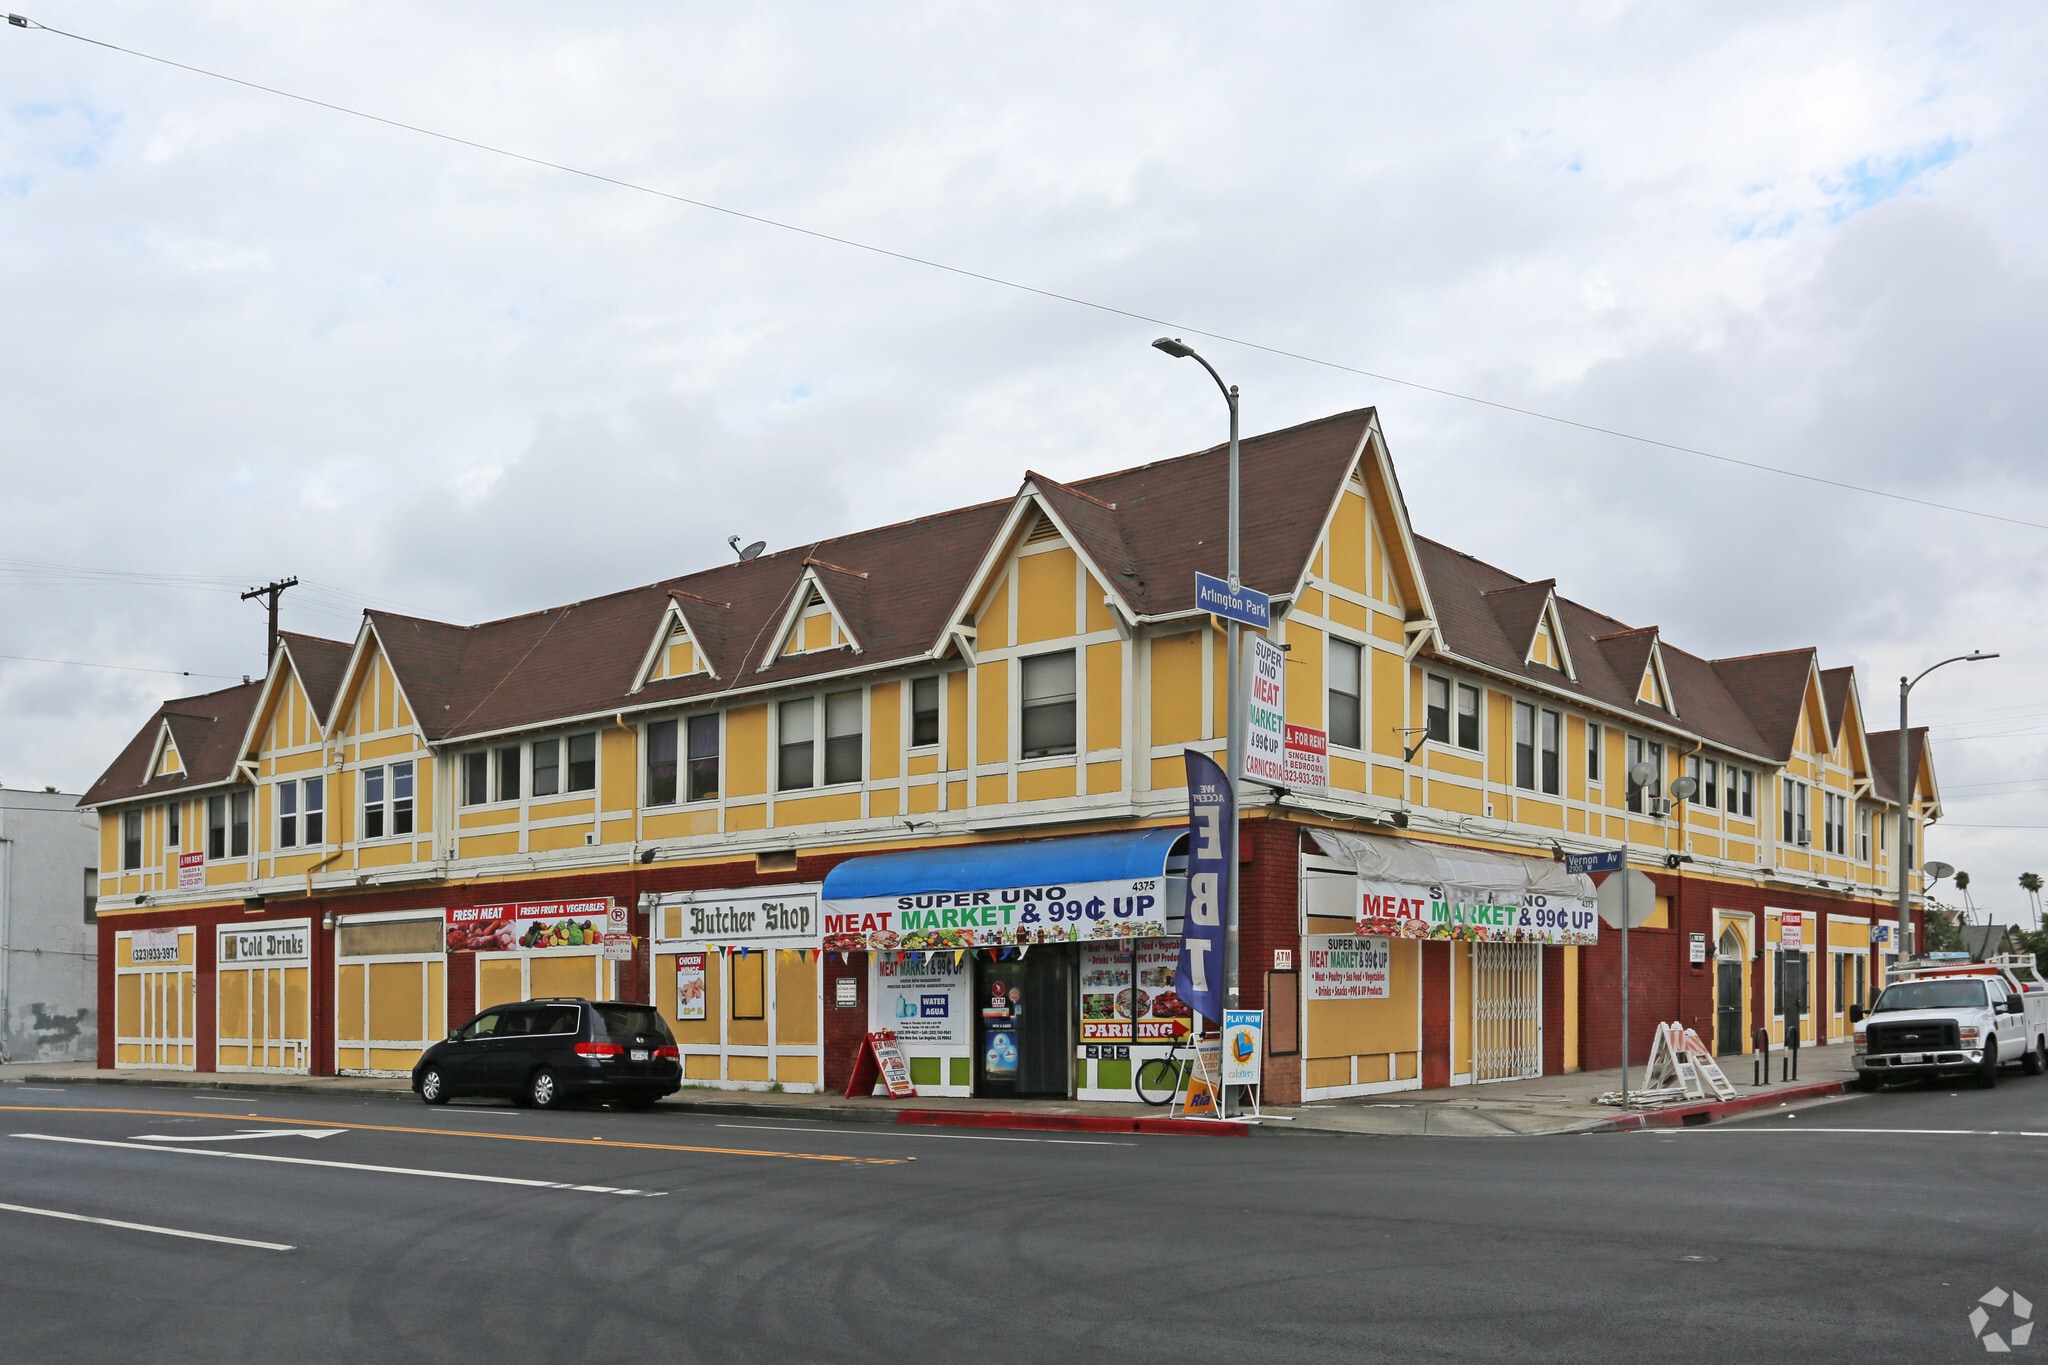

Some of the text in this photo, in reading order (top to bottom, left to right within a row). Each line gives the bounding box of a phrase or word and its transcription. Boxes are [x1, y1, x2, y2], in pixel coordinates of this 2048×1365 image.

[1201, 586, 1266, 617] Arlington Park
[1256, 642, 1282, 668] SUPER
[1259, 660, 1276, 680] UNO
[1254, 675, 1280, 707] MEAT
[1250, 704, 1283, 734] MARKET
[1255, 733, 1269, 752] 99¢
[1269, 739, 1279, 754] UP
[1294, 731, 1326, 750] FOR RENT
[1288, 751, 1321, 764] SINGLES &
[1246, 755, 1283, 782] CARNICERIA
[1290, 761, 1323, 774] BEDROOMS
[1285, 769, 1326, 787] 323-933-3971
[1569, 853, 1617, 866] Vernon Av
[1569, 865, 1583, 873] 2100
[1132, 881, 1156, 892] 4375
[897, 887, 1067, 910] SUPER UNO
[1581, 900, 1594, 909] 4375
[453, 907, 503, 921] FRESH MEAT
[520, 902, 605, 916] FRESH FRUIT & VEGETABLES
[824, 895, 1155, 933] MEAT MARKET & 99¢ UP
[1362, 893, 1594, 930] MEAT MARKET & 99¢ UP
[690, 903, 810, 934] Butcher Shop
[267, 933, 303, 955] Drinks
[1141, 941, 1154, 951] Food
[1159, 940, 1180, 952] Vegetab
[1328, 939, 1371, 950] SUPER UNO
[133, 947, 178, 961] (323)933-3971
[679, 956, 701, 966] CHICKEN
[1092, 955, 1108, 965] Drinks
[1153, 954, 1161, 962] UP
[1275, 951, 1290, 962] ATM
[1310, 949, 1388, 969] MEAT MARKET & 99¢ UP
[681, 966, 700, 976] WINGS
[880, 961, 898, 977] MEAT
[1227, 1015, 1261, 1023] PLAY NOW
[1084, 1023, 1173, 1037] PARKING
[1191, 1091, 1211, 1107] Ria
